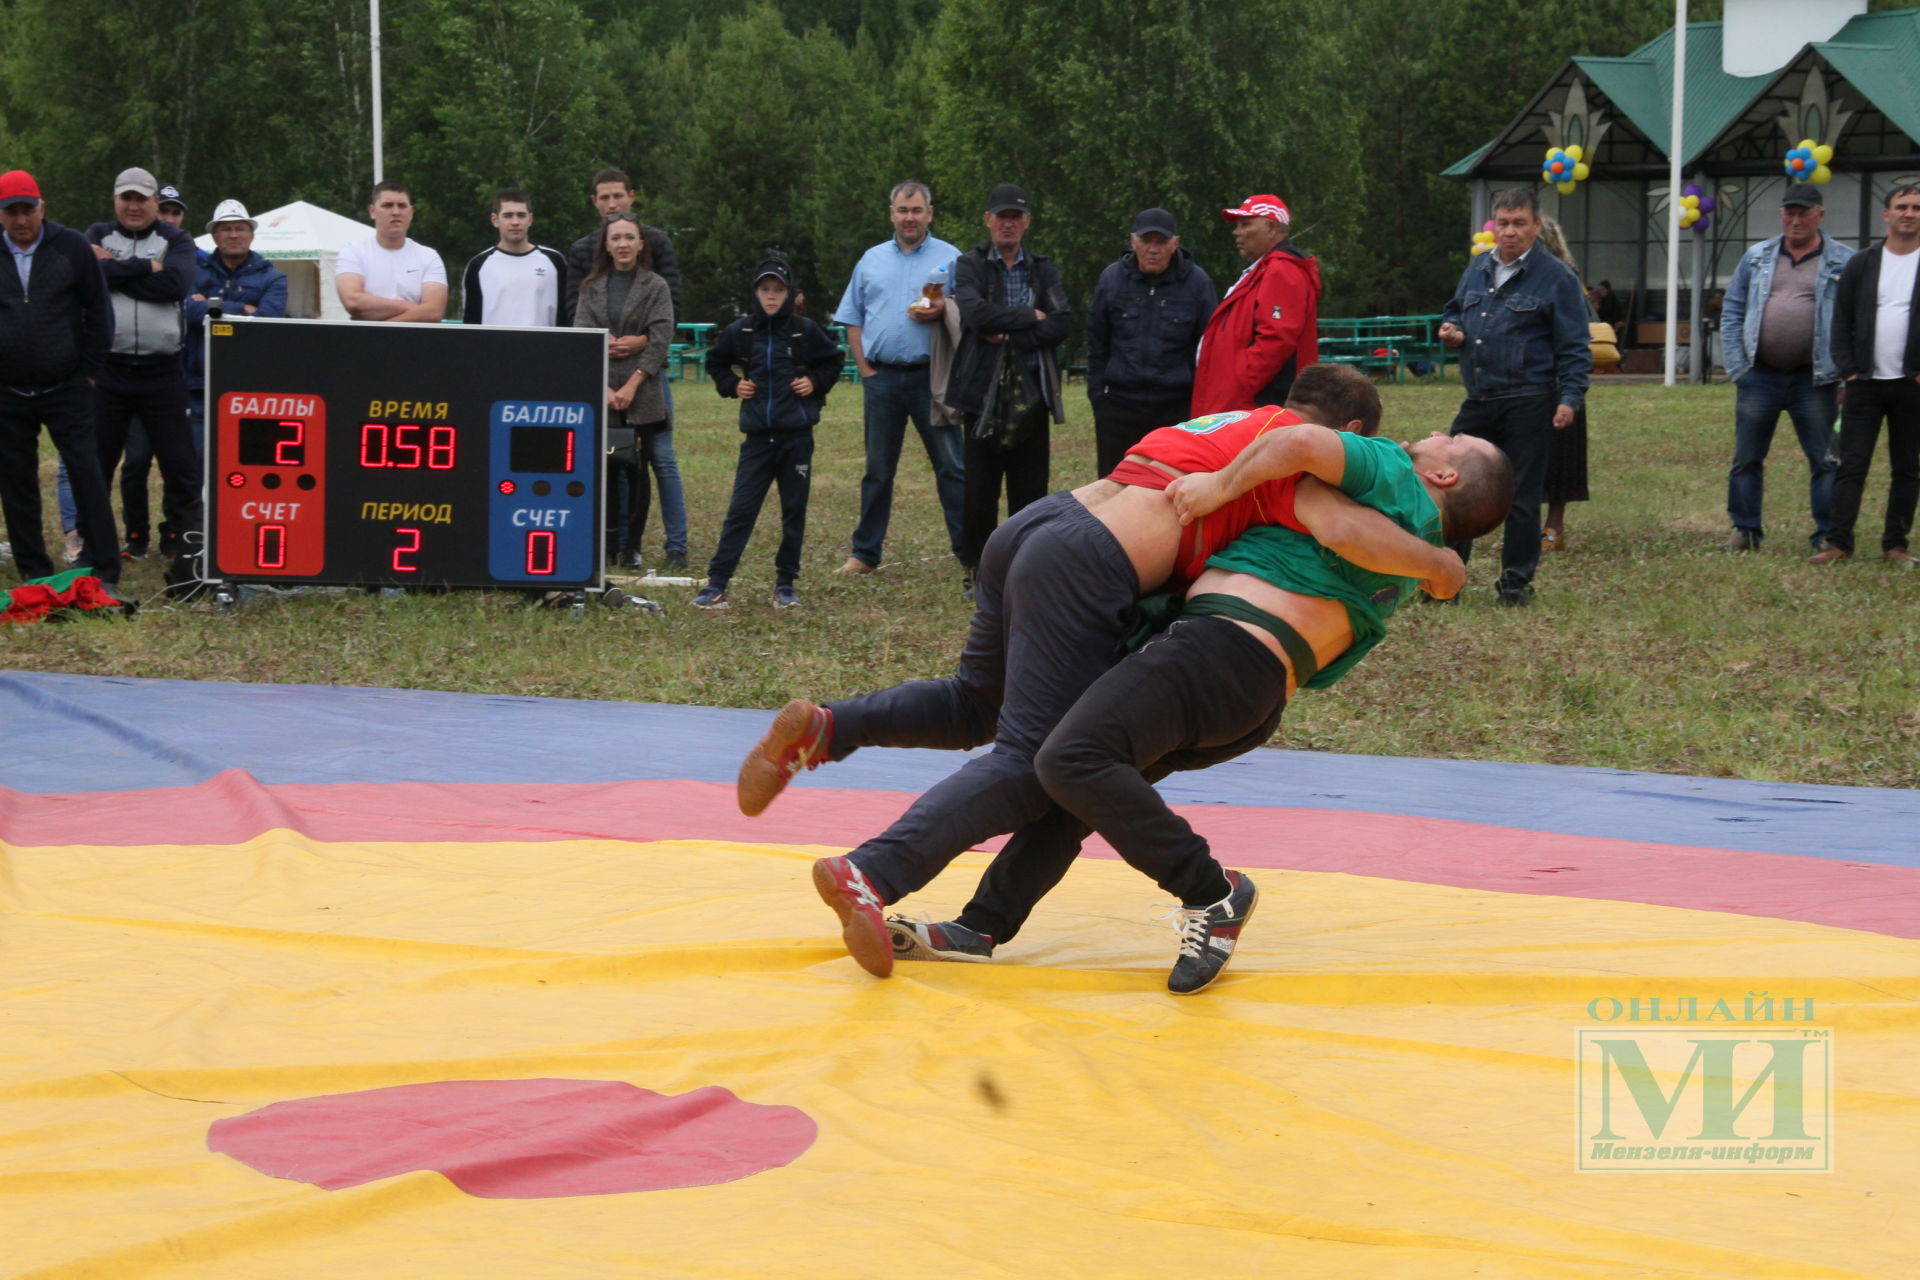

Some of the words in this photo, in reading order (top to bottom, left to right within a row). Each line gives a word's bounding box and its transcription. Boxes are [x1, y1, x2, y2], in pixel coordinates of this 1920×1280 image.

[229, 396, 315, 417] БАЛЛЫ
[368, 400, 449, 420] ВРЕМЯ
[500, 405, 584, 424] БАЛЛЫ
[275, 421, 303, 465] 2
[565, 430, 574, 472] 1
[241, 501, 301, 521] СЧЕТ
[361, 503, 452, 525] ПЕРИОД
[512, 508, 571, 527] СЧЕТ
[257, 525, 286, 568] 0
[393, 528, 421, 571] 2
[527, 531, 555, 574] 0
